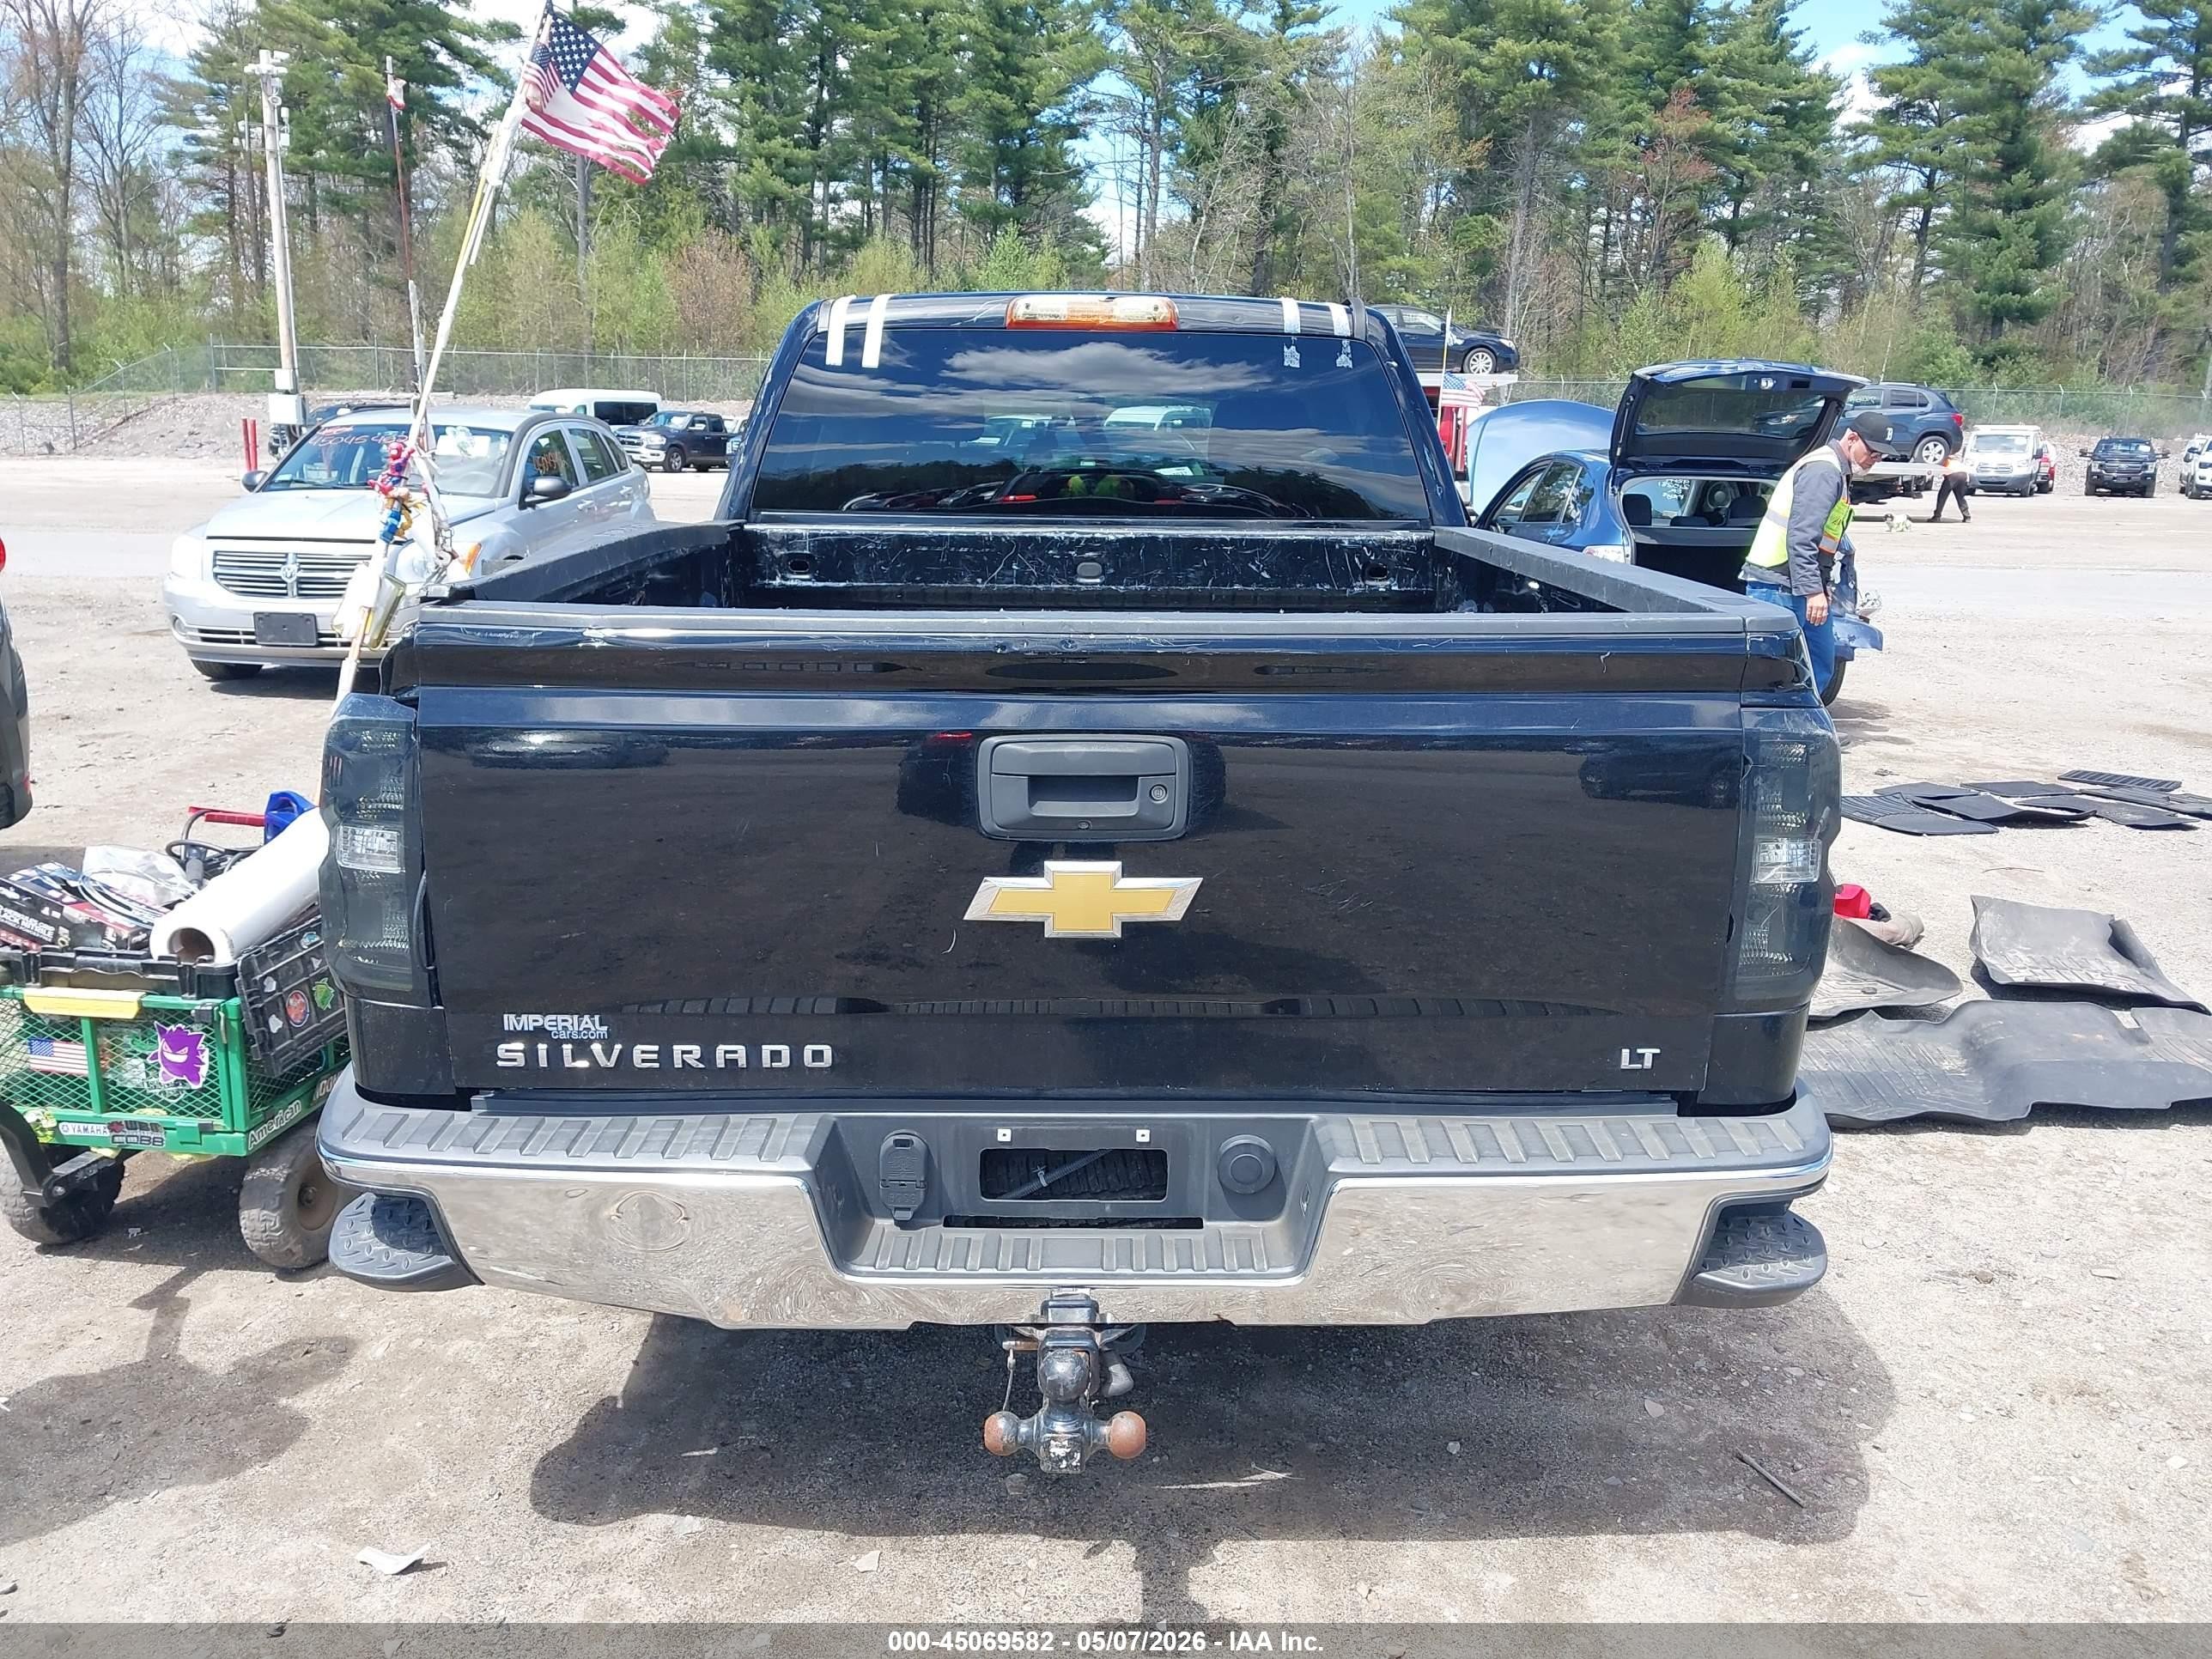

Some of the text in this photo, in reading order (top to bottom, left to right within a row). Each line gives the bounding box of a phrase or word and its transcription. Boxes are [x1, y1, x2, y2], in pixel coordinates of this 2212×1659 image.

[502, 1014, 609, 1030] IMPERIAL
[550, 1030, 608, 1040] cars.com
[496, 1042, 833, 1068] SILVERADO
[1620, 1048, 1661, 1069] LT
[71, 1124, 108, 1134] YAMAHA
[248, 1100, 301, 1151] American
[111, 1134, 164, 1146] COBB
